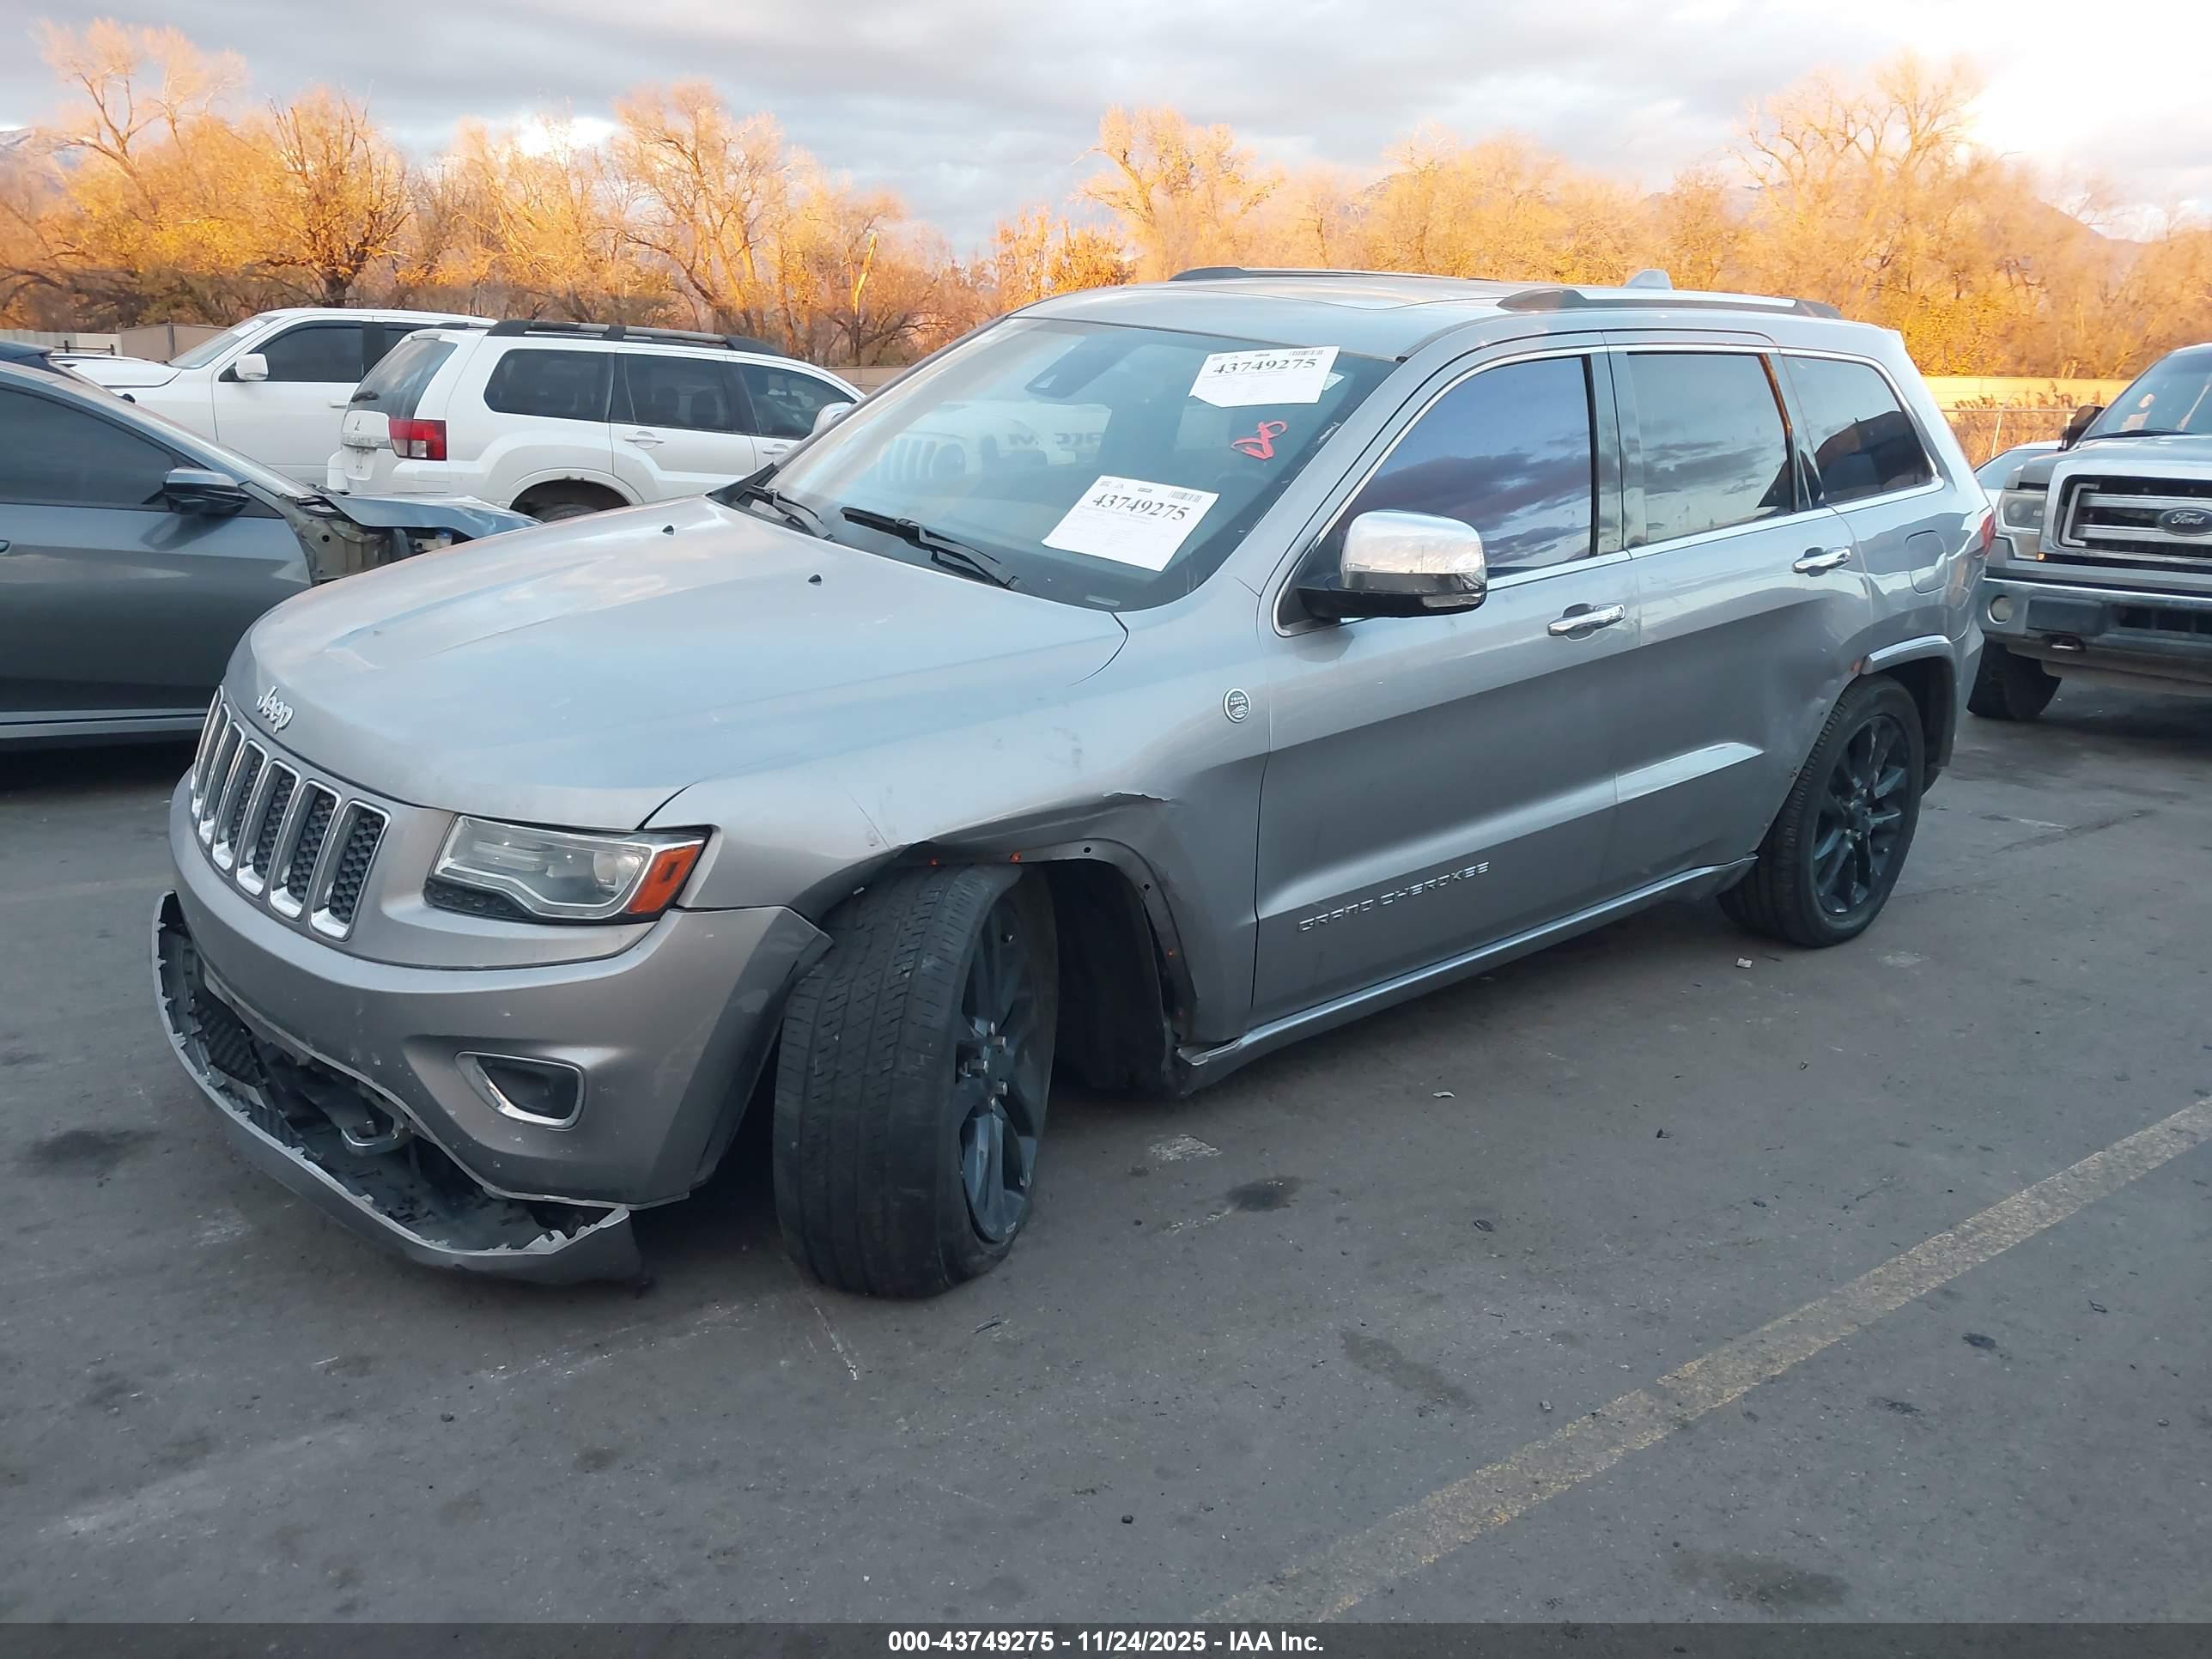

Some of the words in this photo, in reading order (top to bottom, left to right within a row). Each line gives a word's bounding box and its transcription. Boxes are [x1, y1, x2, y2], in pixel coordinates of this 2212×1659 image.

[1213, 358, 1317, 374] 43749275
[1092, 493, 1191, 520] 43749275
[2171, 512, 2205, 525] Ford
[256, 685, 295, 734] Jeep
[1380, 861, 1490, 905] CHEROKEE
